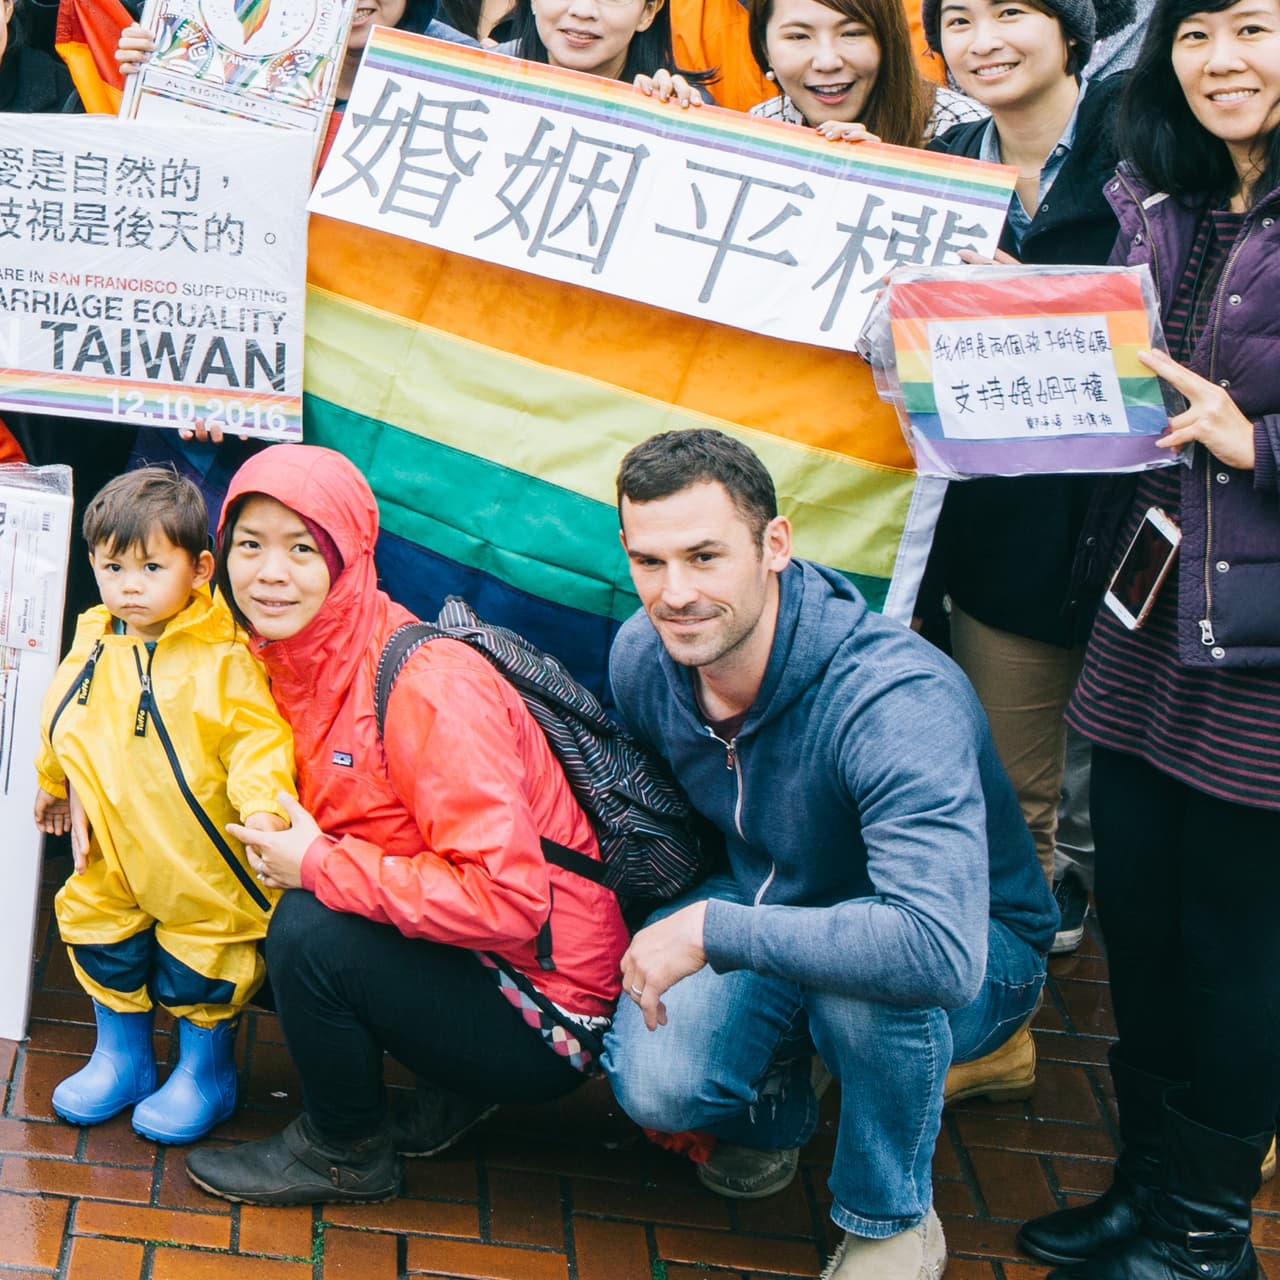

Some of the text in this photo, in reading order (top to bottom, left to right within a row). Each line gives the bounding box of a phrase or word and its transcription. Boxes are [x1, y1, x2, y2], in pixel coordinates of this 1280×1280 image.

[321, 77, 989, 333] 婚姻平權
[29, 270, 44, 284] IN
[48, 271, 81, 286] SAN
[85, 274, 178, 296] FRANCISCO
[181, 282, 288, 305] SUPPORTING
[133, 297, 288, 336] EQUALITY
[41, 320, 288, 393] TAIWAN
[107, 390, 288, 431] 12.10.2016
[951, 371, 1108, 414] 支持婚姻平權
